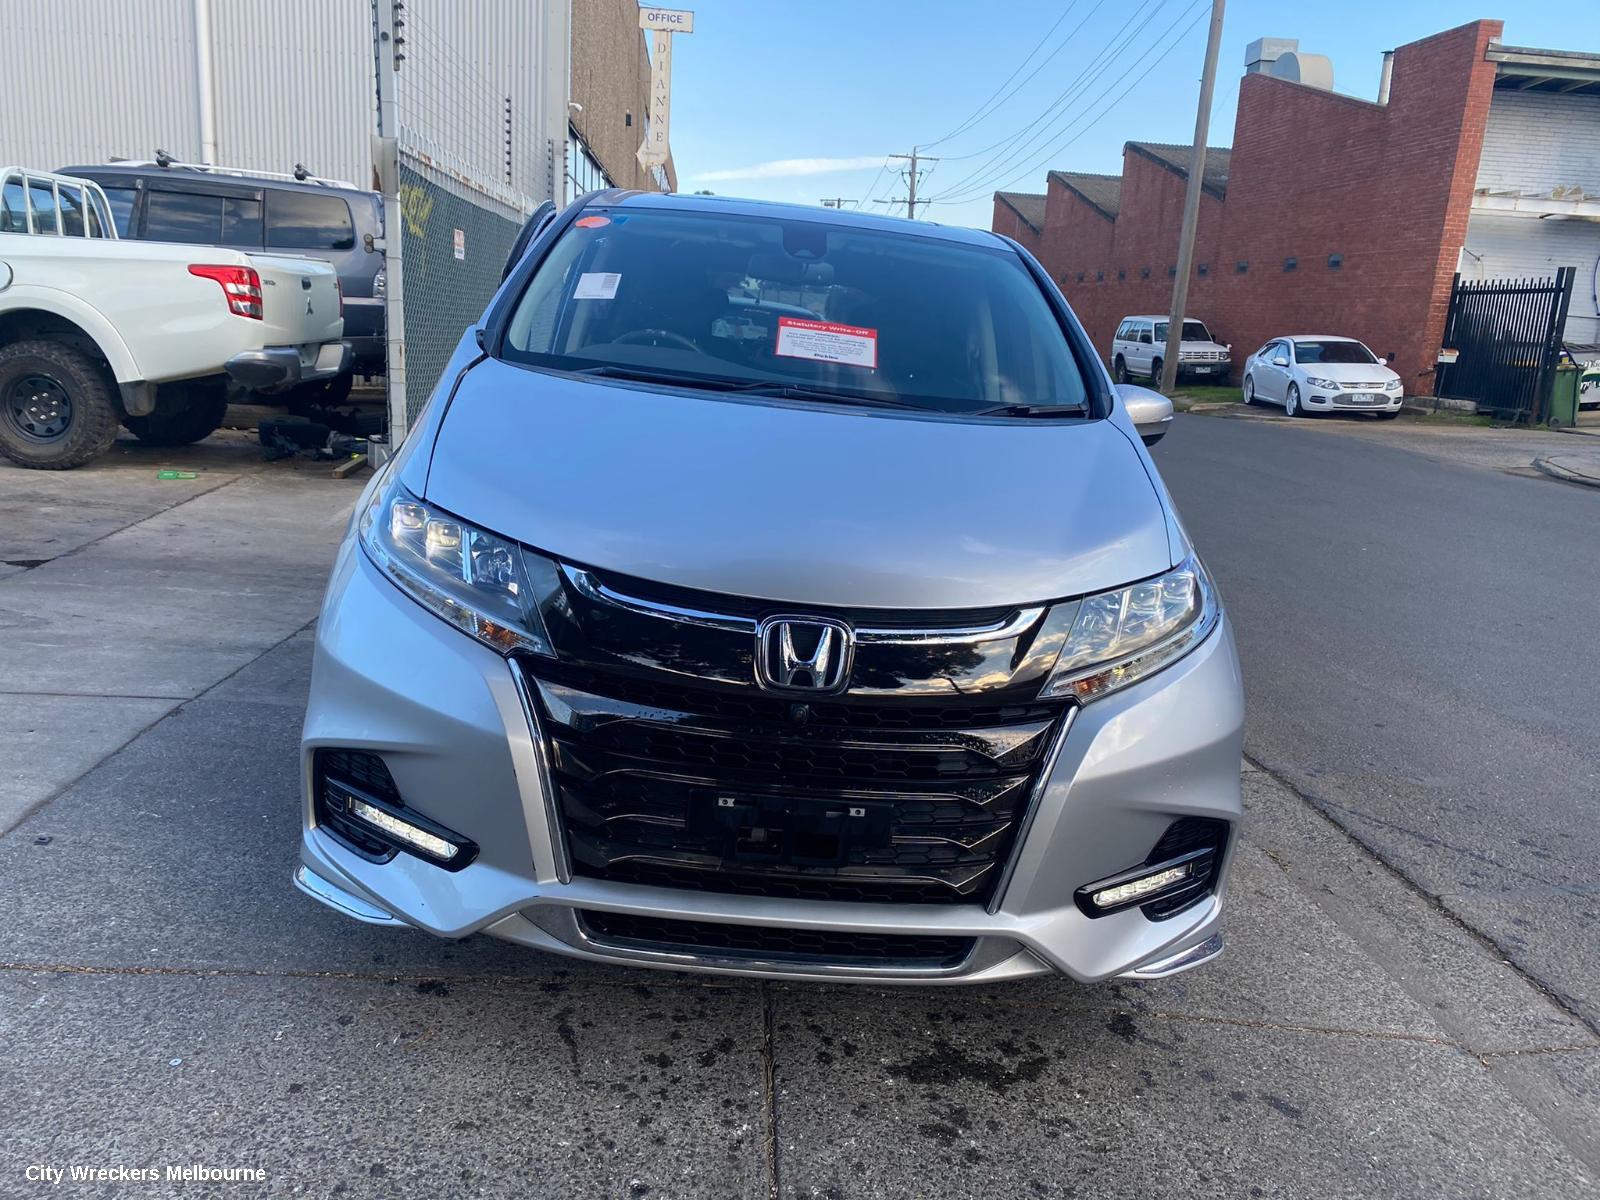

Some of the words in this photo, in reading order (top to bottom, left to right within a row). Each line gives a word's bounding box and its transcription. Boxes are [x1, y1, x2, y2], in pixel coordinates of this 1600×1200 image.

[647, 12, 684, 24] OFFICE
[655, 42, 667, 143] DIANNE
[786, 320, 828, 331] Statutory
[829, 324, 869, 335] Write-Off
